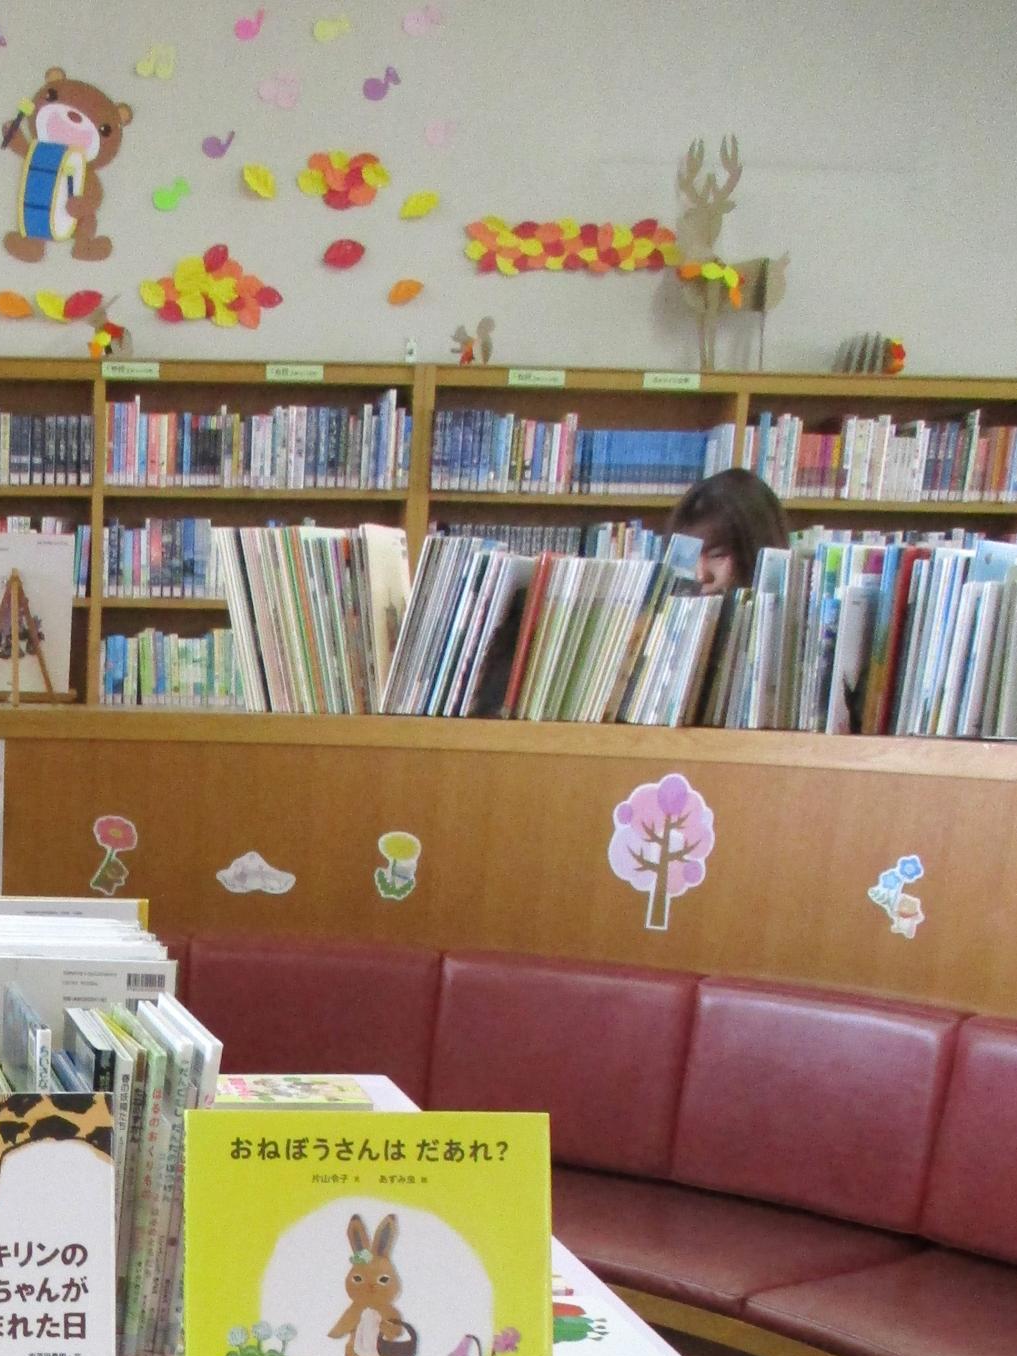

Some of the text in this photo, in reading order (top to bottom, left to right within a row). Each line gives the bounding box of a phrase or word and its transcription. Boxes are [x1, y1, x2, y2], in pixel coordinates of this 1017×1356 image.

[229, 1137, 406, 1162] おねぼうさんは
